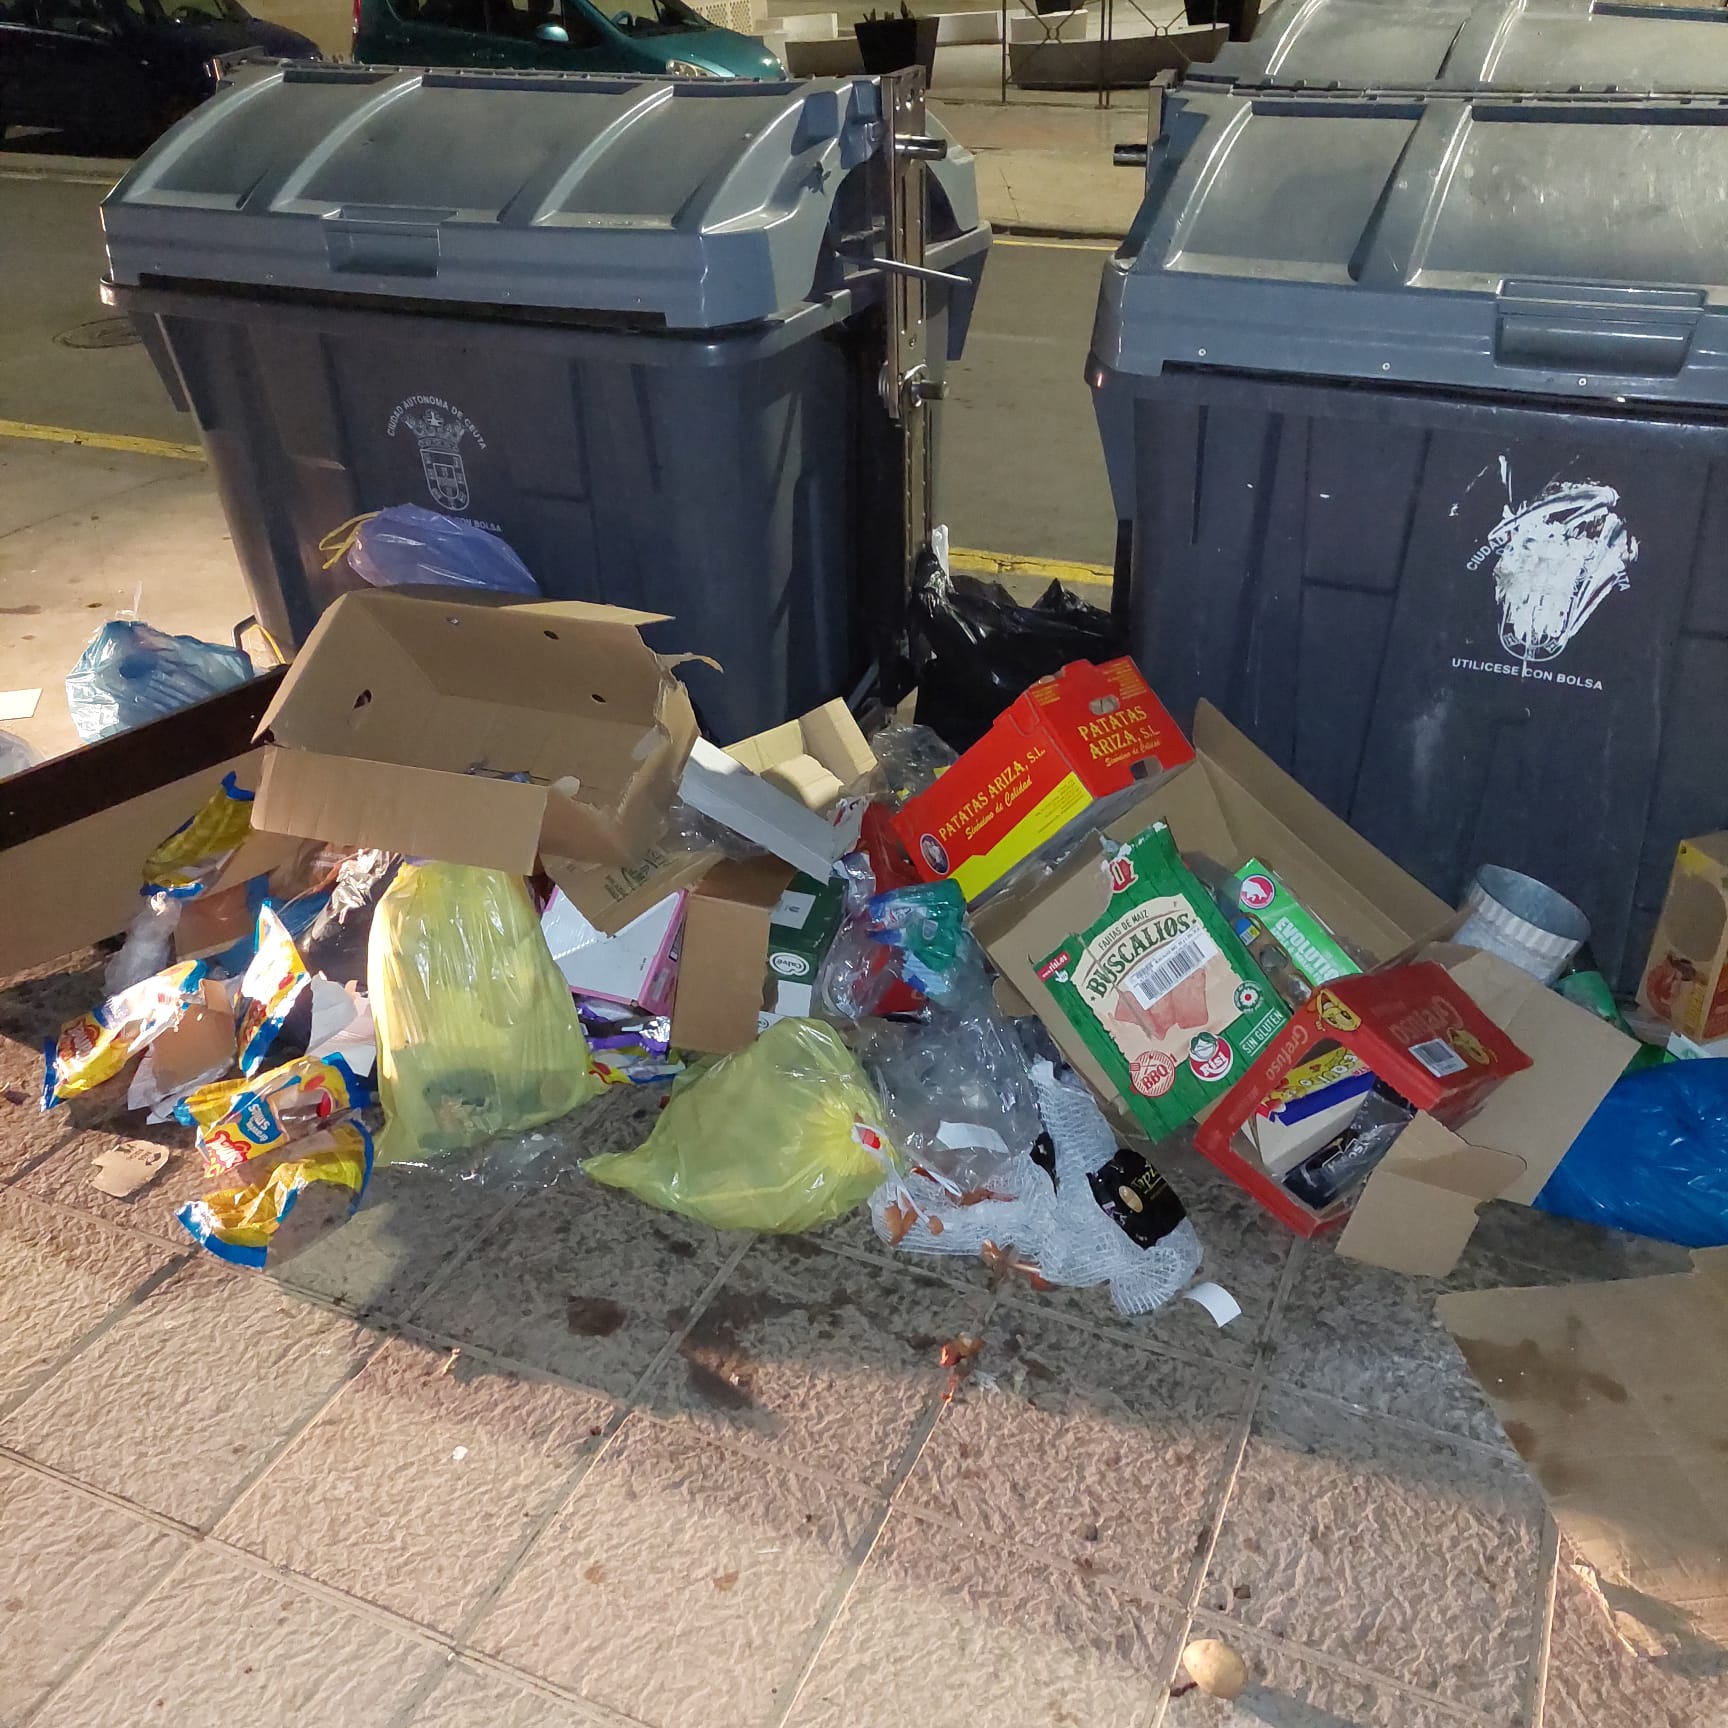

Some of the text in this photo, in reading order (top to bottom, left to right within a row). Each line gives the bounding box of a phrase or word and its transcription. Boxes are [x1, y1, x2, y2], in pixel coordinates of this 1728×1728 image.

[387, 395, 487, 450] CIUDAD AUTONOMA DE CEUTA
[473, 520, 502, 532] BOLSA
[1451, 657, 1603, 691] UTILICESE CON BOLSA
[1077, 705, 1147, 742] PATATAS
[1089, 729, 1141, 760] ARIZA,
[938, 793, 989, 842] PATATAS
[987, 759, 1029, 797] ARIZA,
[1027, 746, 1046, 763] S.L.
[994, 802, 1004, 815] de
[1004, 775, 1033, 807] Calidad
[1097, 926, 1122, 951] FAJITAS
[1120, 919, 1131, 931] DE
[1242, 1011, 1284, 1055] SIN GLUTEN
[1140, 1067, 1168, 1090] BBQ
